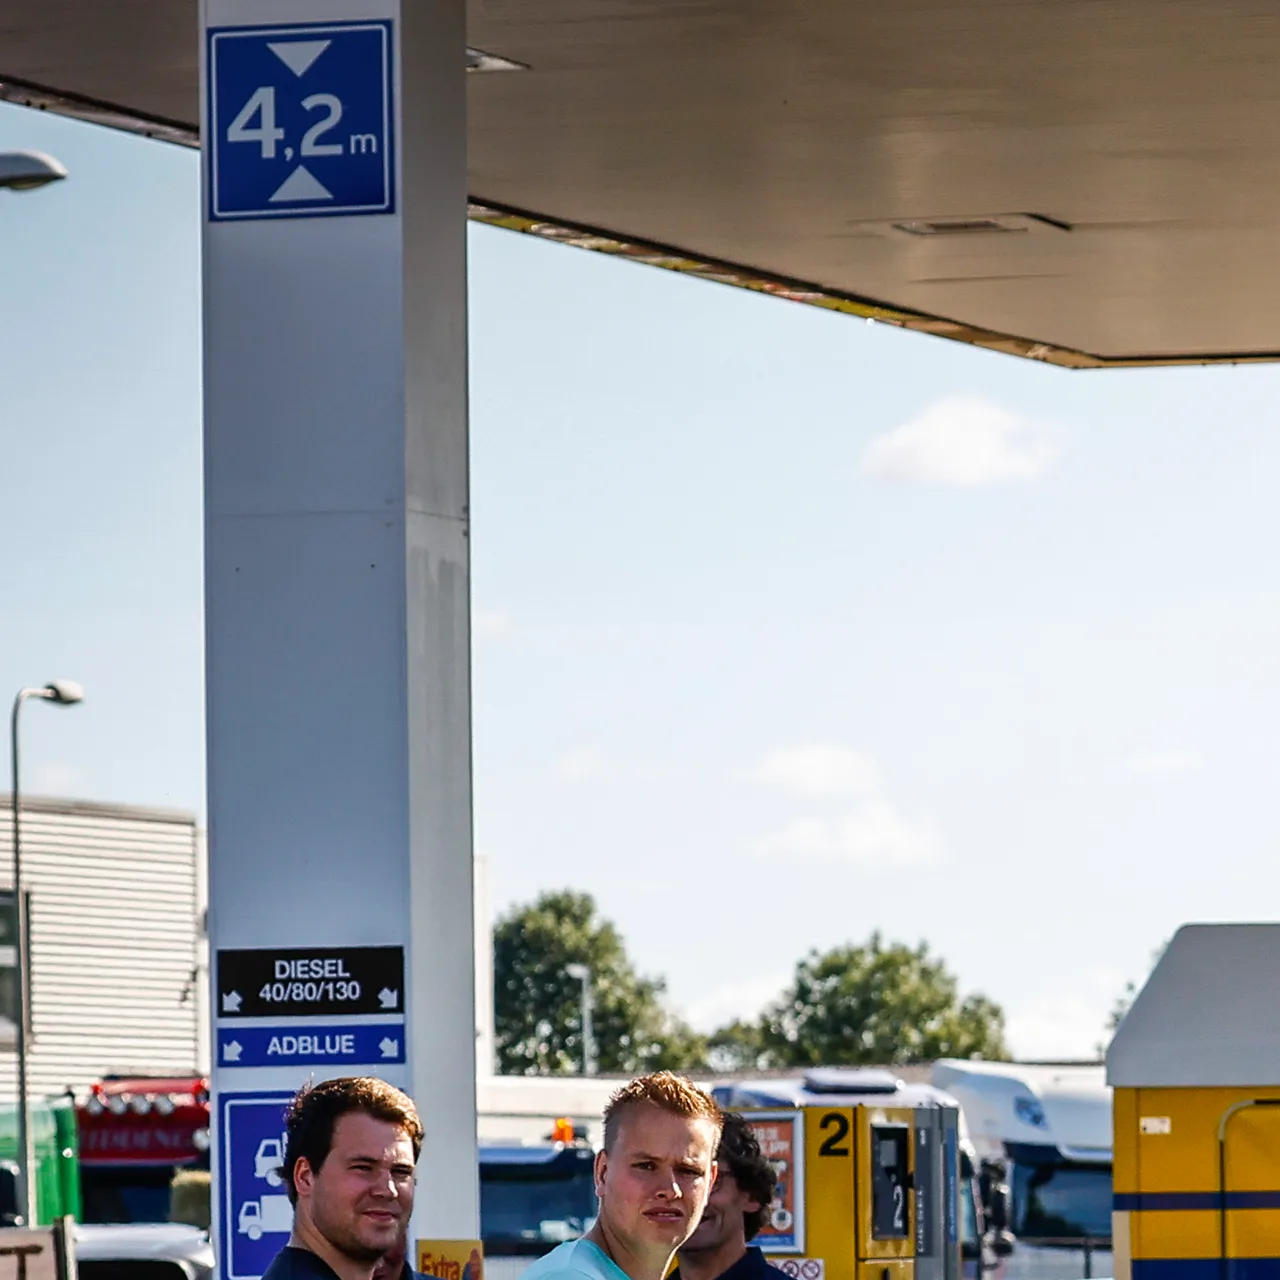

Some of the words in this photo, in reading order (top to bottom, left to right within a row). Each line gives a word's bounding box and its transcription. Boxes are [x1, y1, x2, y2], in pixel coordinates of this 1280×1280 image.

[227, 86, 343, 162] 4,2
[350, 133, 377, 154] m
[274, 958, 351, 979] DIESEL
[259, 981, 361, 1001] 40/80/130
[267, 1034, 356, 1056] ADBLUE
[818, 1112, 849, 1157] 2
